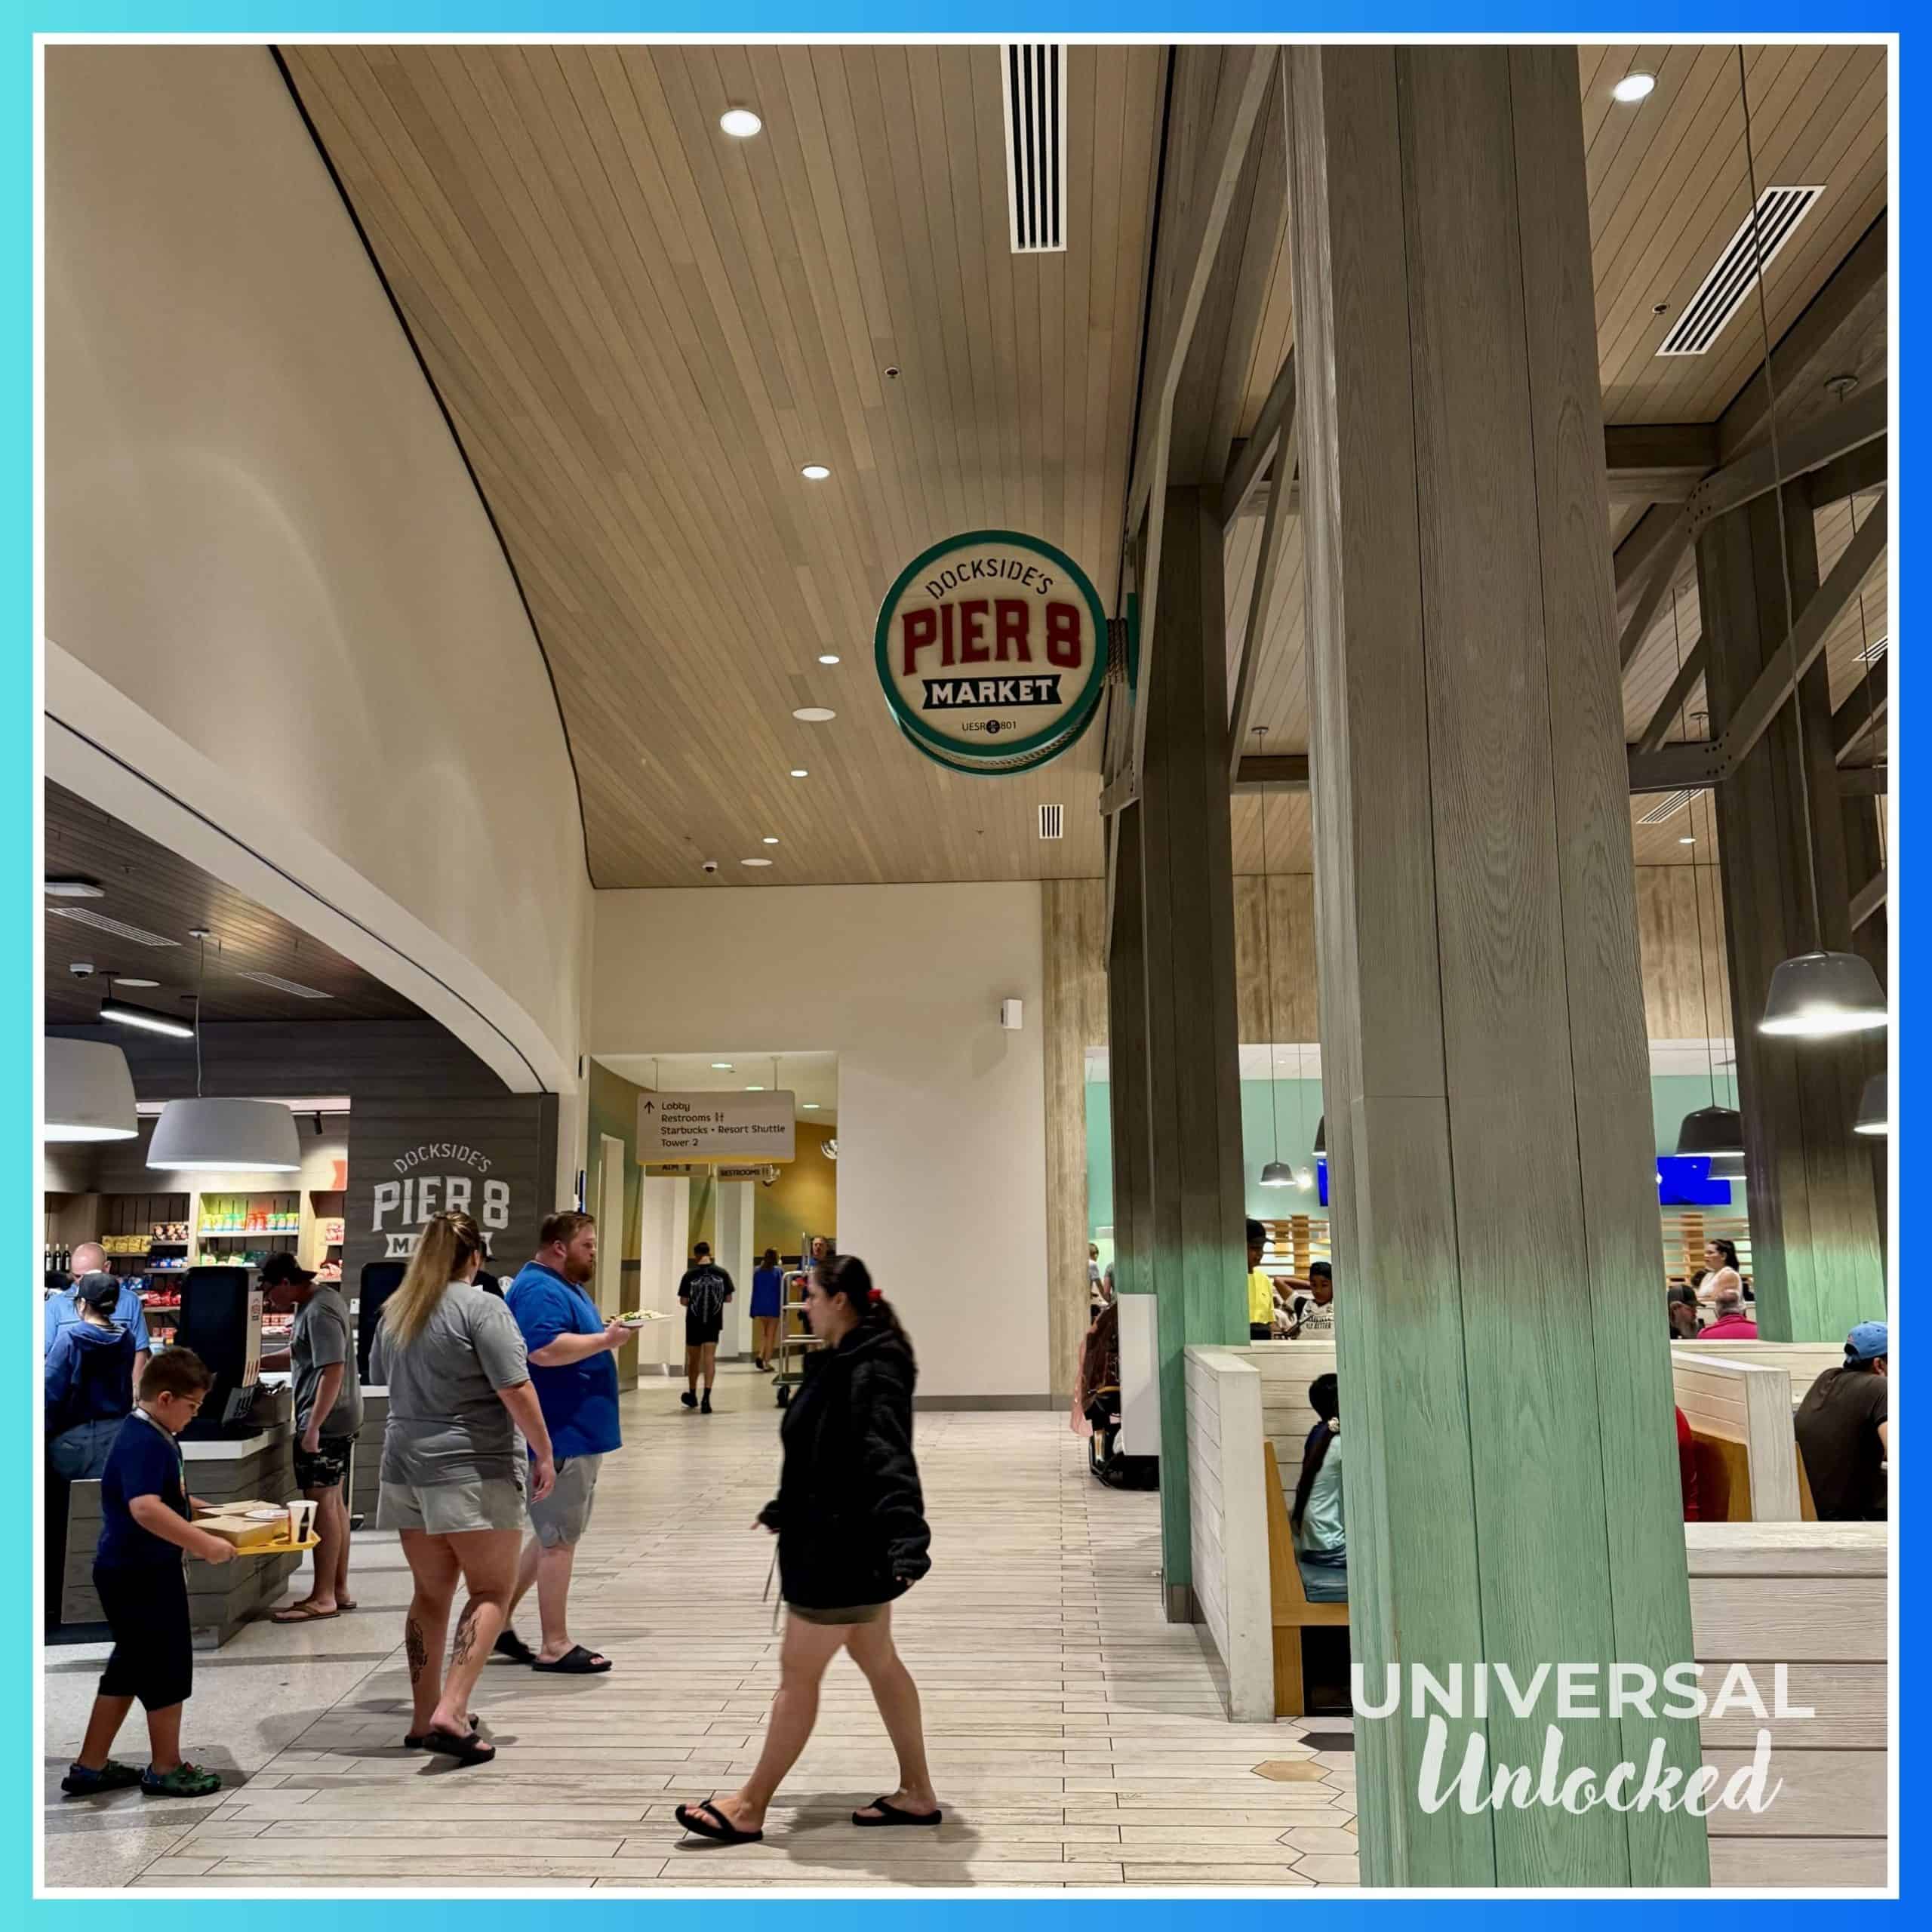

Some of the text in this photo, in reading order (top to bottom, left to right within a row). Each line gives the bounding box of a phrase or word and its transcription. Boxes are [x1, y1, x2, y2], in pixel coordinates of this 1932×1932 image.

[925, 558, 1053, 599] DOCKSIDE'S
[902, 599, 1081, 676] PIER 8
[931, 679, 1053, 705] MARKET
[1001, 721, 1017, 730] 801
[662, 1103, 690, 1112] Lobby
[661, 1125, 708, 1134] Starbucks
[752, 1124, 785, 1133] Shuttle
[661, 1138, 698, 1146] Tower 2
[393, 1143, 491, 1174] DOCKSIDE'S
[372, 1176, 509, 1232] PIER 8
